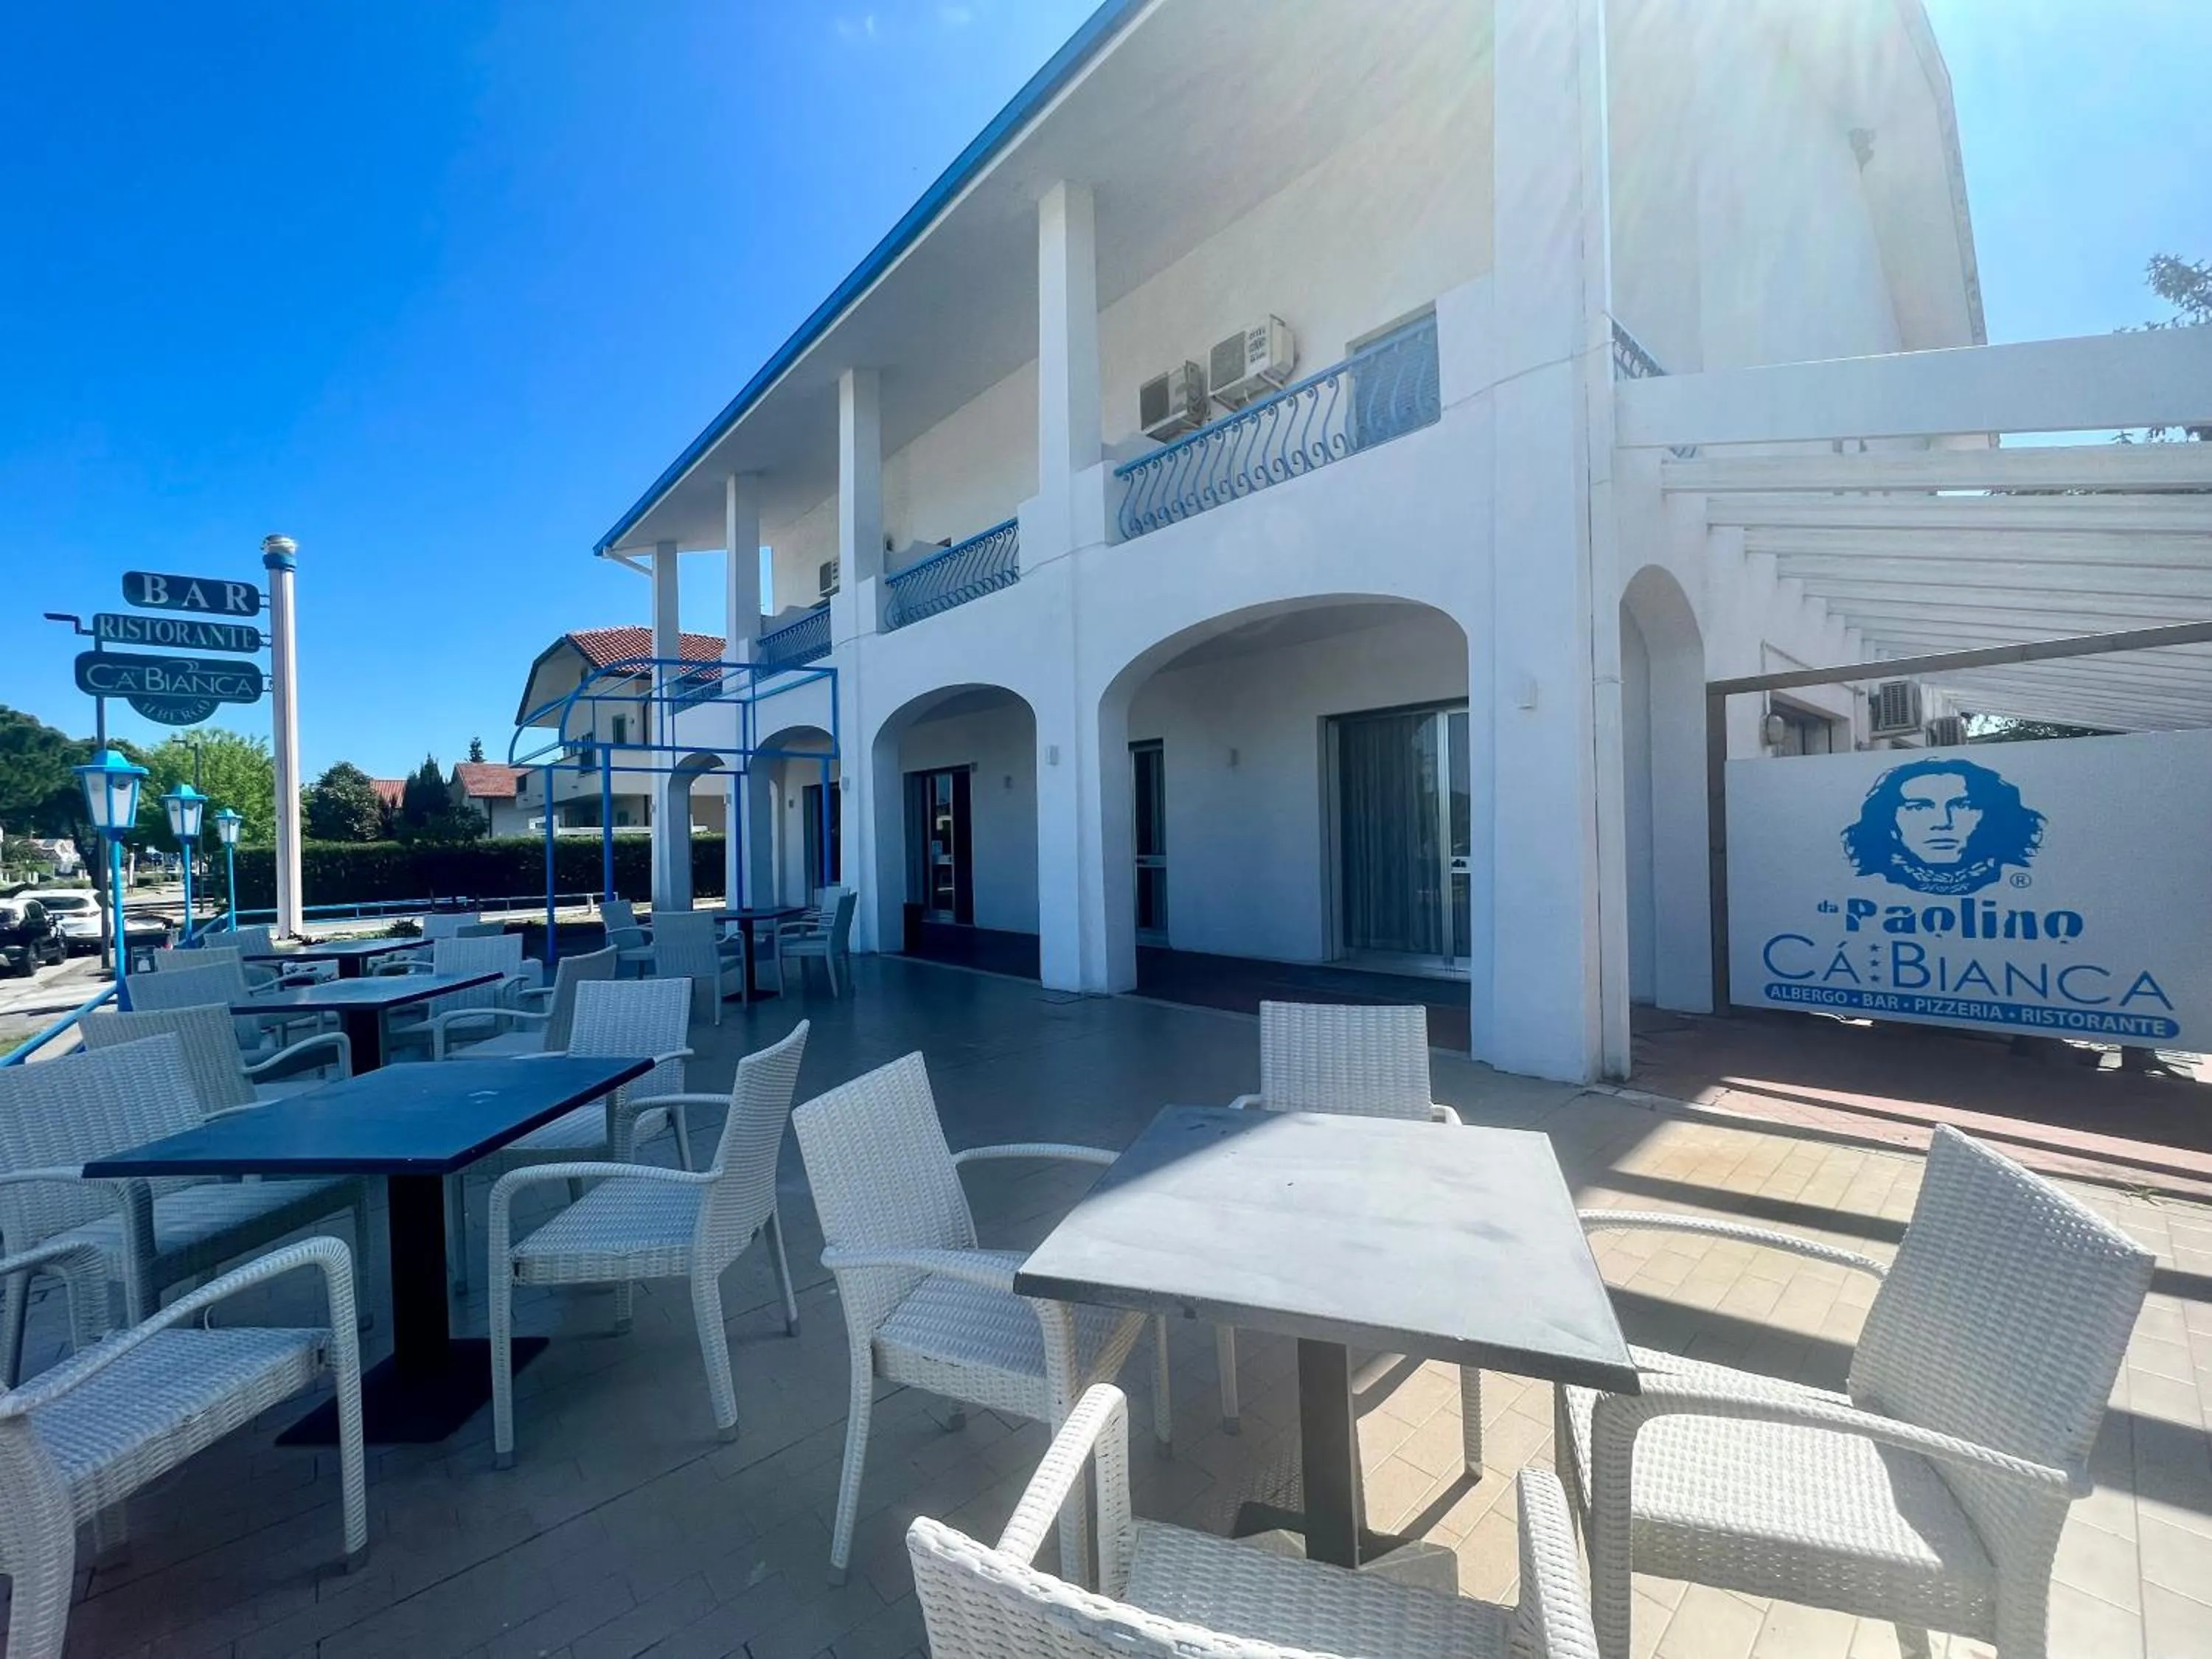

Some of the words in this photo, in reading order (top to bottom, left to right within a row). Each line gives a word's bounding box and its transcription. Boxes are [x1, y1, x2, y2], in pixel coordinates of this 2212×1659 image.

[142, 574, 250, 613] BAR
[99, 616, 256, 650] RISTORANTE
[145, 667, 254, 695] BIANCA
[1817, 900, 1839, 914] da
[1846, 897, 2083, 944] Paolino
[1891, 940, 2175, 1011] BIANCA
[1770, 984, 1848, 1005] ALBERGO
[1863, 993, 1899, 1010] BAR
[1915, 998, 2003, 1019] PIZZERIA
[2021, 1007, 2167, 1036] RISTORANTE
